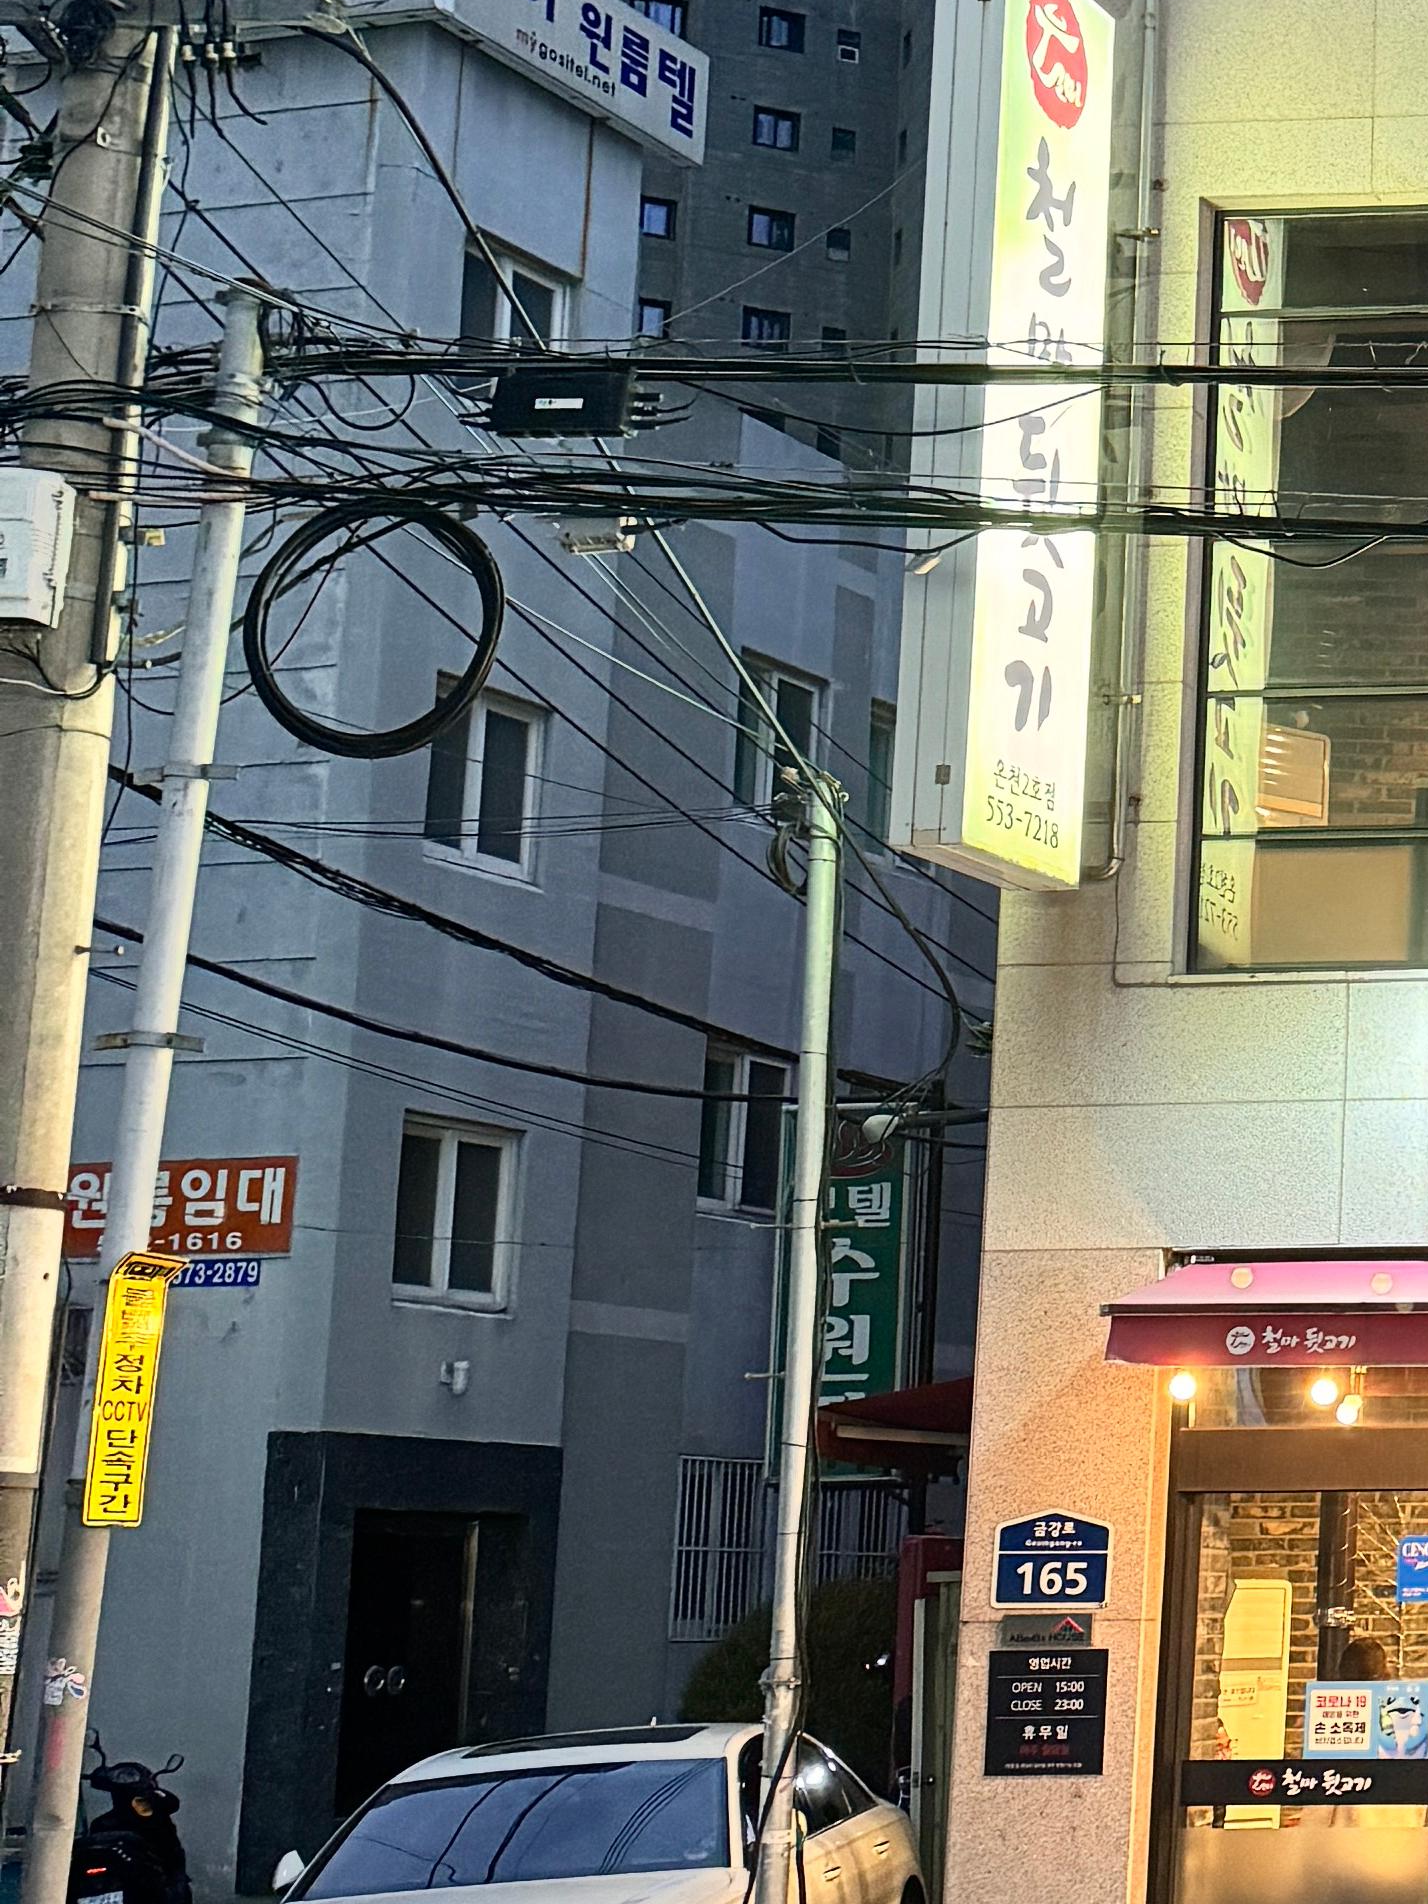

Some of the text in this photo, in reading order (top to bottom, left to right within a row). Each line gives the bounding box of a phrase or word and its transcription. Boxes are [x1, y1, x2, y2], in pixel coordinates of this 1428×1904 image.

[578, 0, 697, 139] 원룸텔
[993, 758, 1056, 812] 온천2호점
[986, 794, 1059, 849] 553-7218
[1261, 1325, 1357, 1354] 철마 뒷고기
[102, 1399, 148, 1423] CCTV
[99, 1428, 139, 1514] 단속구간
[1033, 1522, 1076, 1538] 금강로
[1016, 1561, 1089, 1596] 165
[1028, 1657, 1072, 1671] 영업시간
[1012, 1681, 1085, 1693] OPEN 15:00
[1011, 1699, 1085, 1711] CLOSE 23:00
[1316, 1695, 1367, 1708] 코로나 19
[1314, 1721, 1366, 1735] 손 소독제
[1281, 1768, 1372, 1795] 철마 뒷고기
